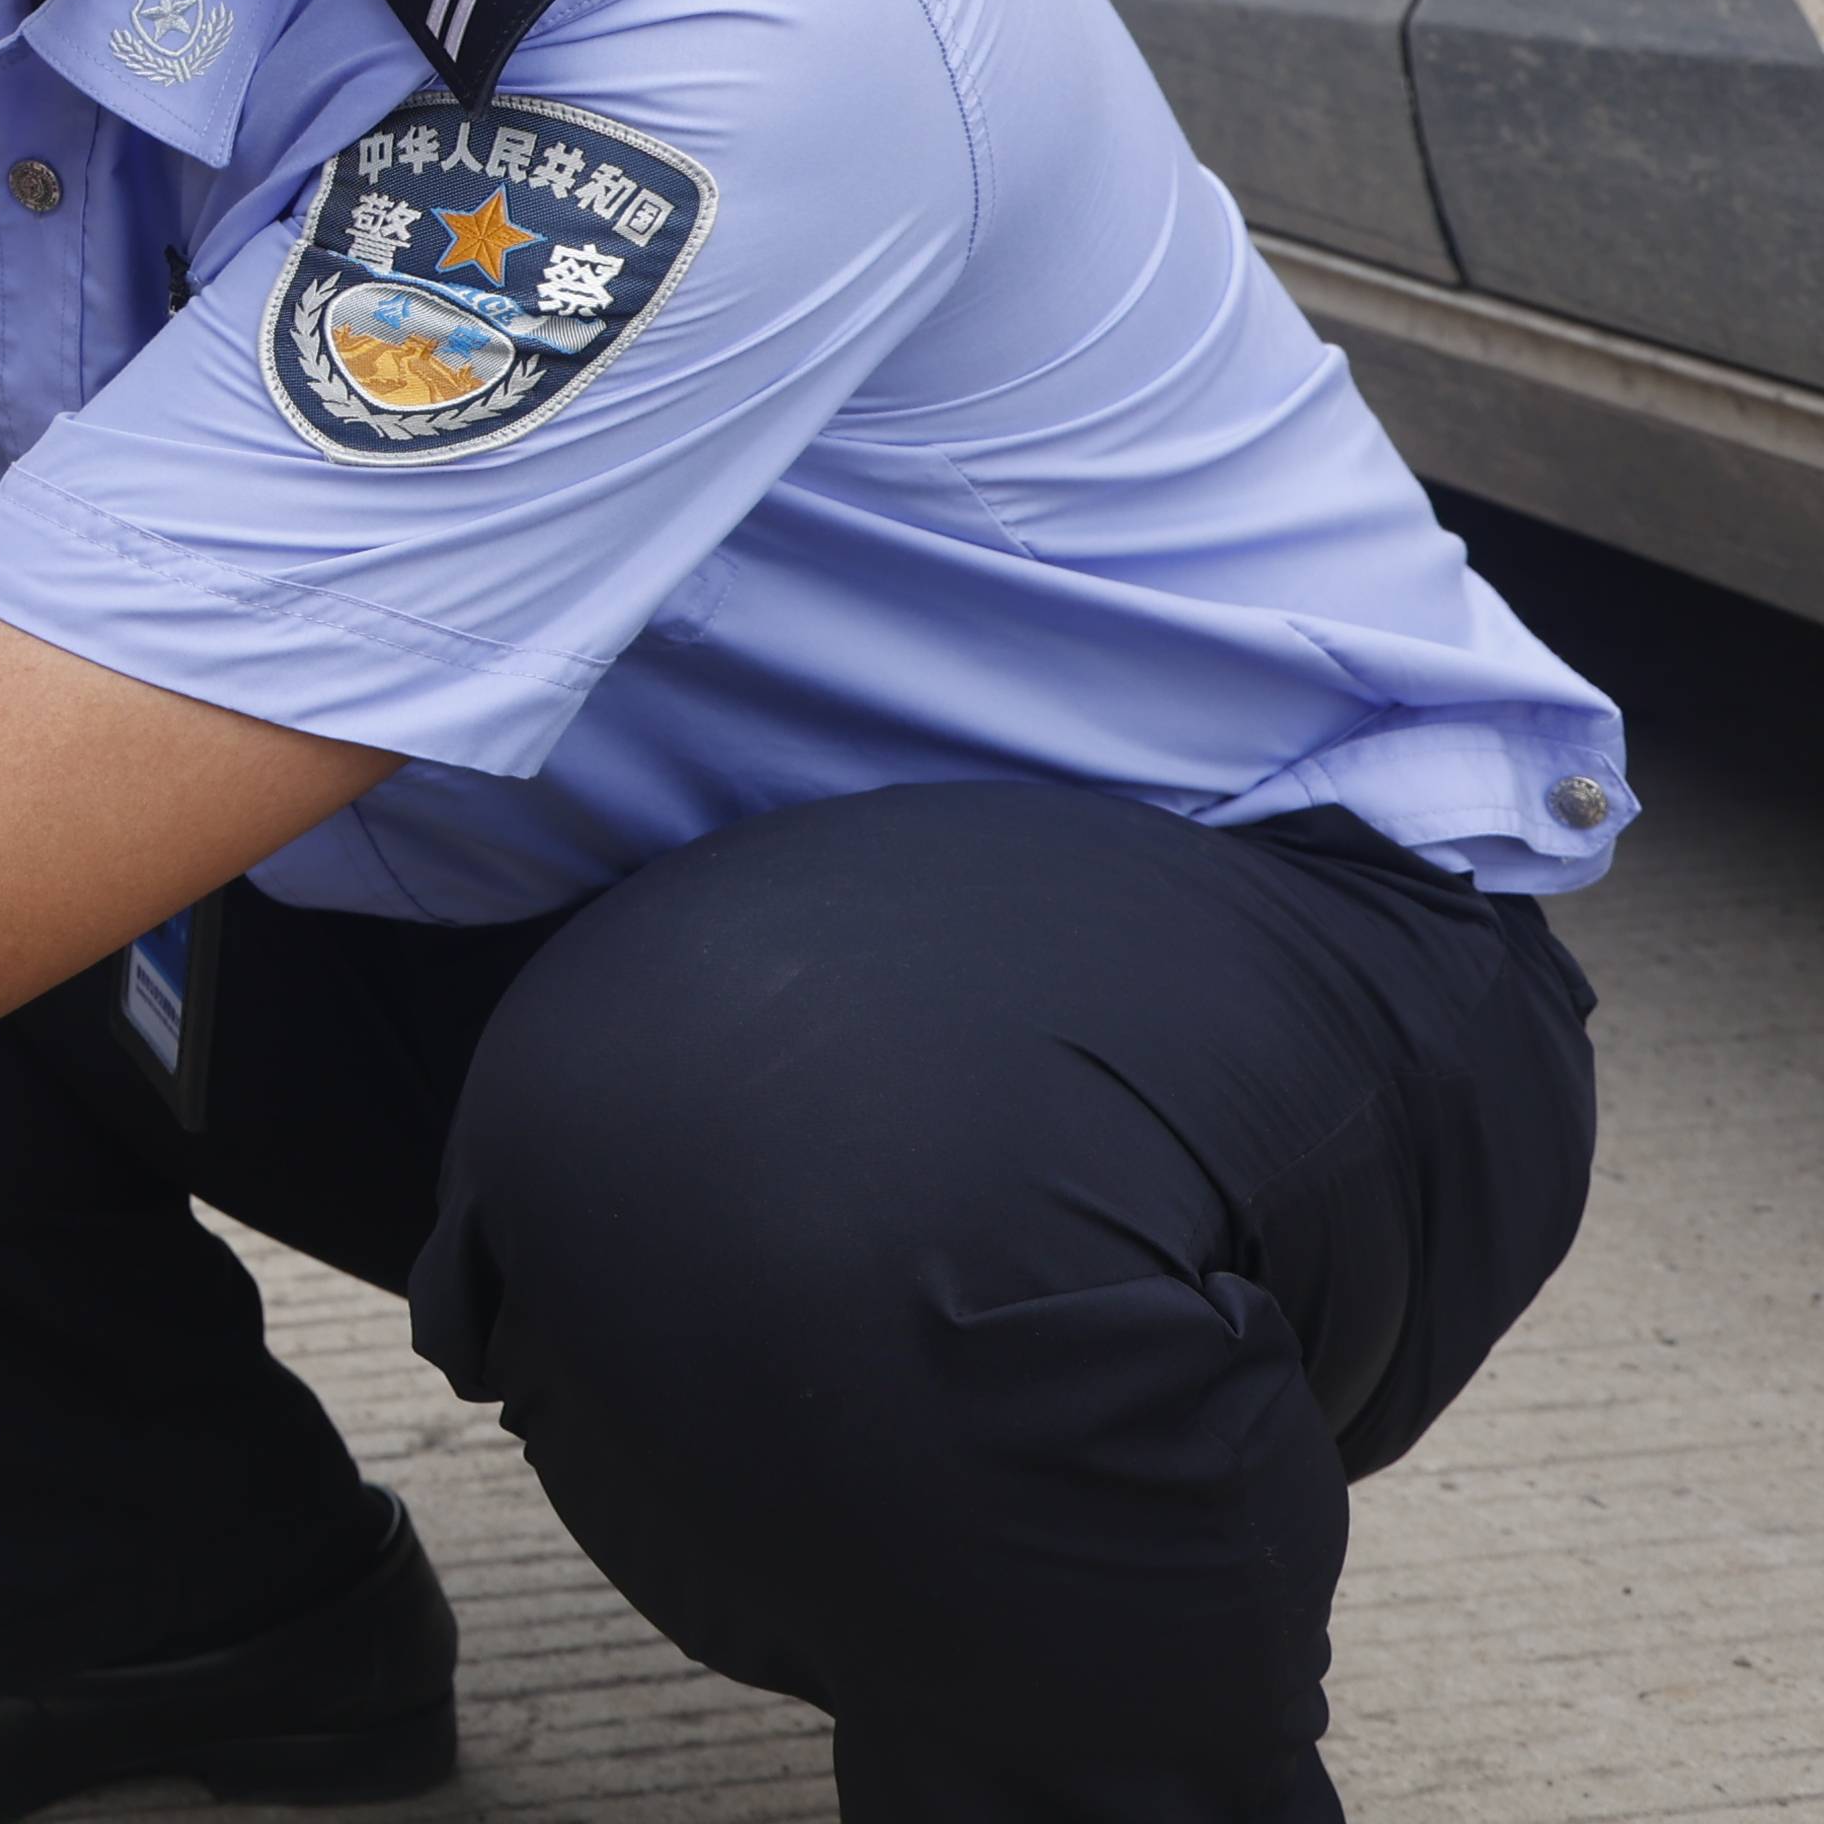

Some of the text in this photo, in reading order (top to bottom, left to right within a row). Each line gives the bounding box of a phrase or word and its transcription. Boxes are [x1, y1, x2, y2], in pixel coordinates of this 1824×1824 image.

[358, 121, 675, 247] 中华人民共和国
[346, 192, 625, 317] 警 察
